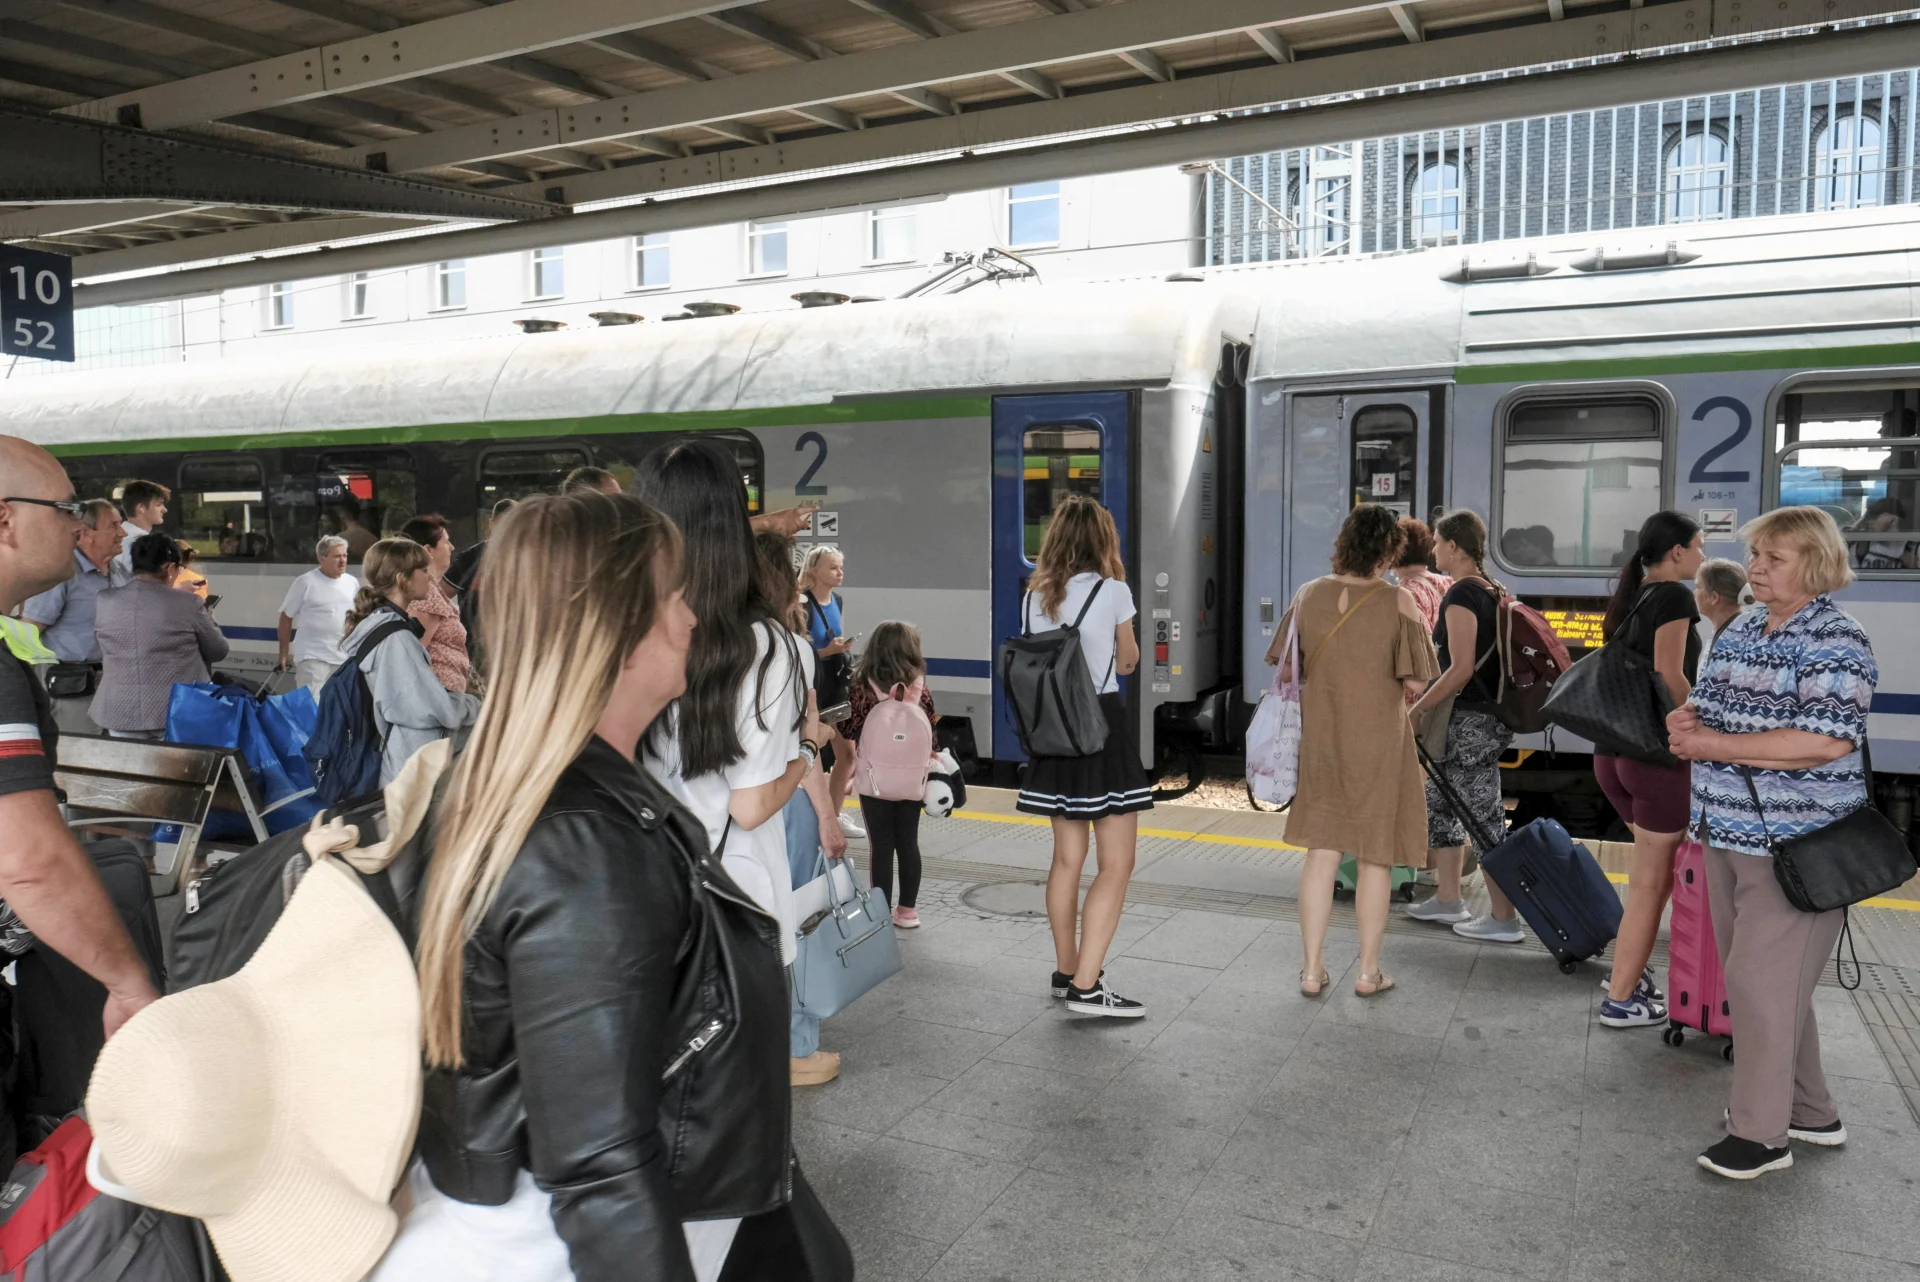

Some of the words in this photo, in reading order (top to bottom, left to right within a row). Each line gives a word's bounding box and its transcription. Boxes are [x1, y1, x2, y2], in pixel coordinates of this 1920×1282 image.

[10, 265, 60, 305] 10
[14, 317, 56, 350] 52
[1688, 395, 1752, 483] 2
[795, 431, 828, 496] 2
[1376, 477, 1390, 492] 15
[1707, 491, 1735, 500] 106-11
